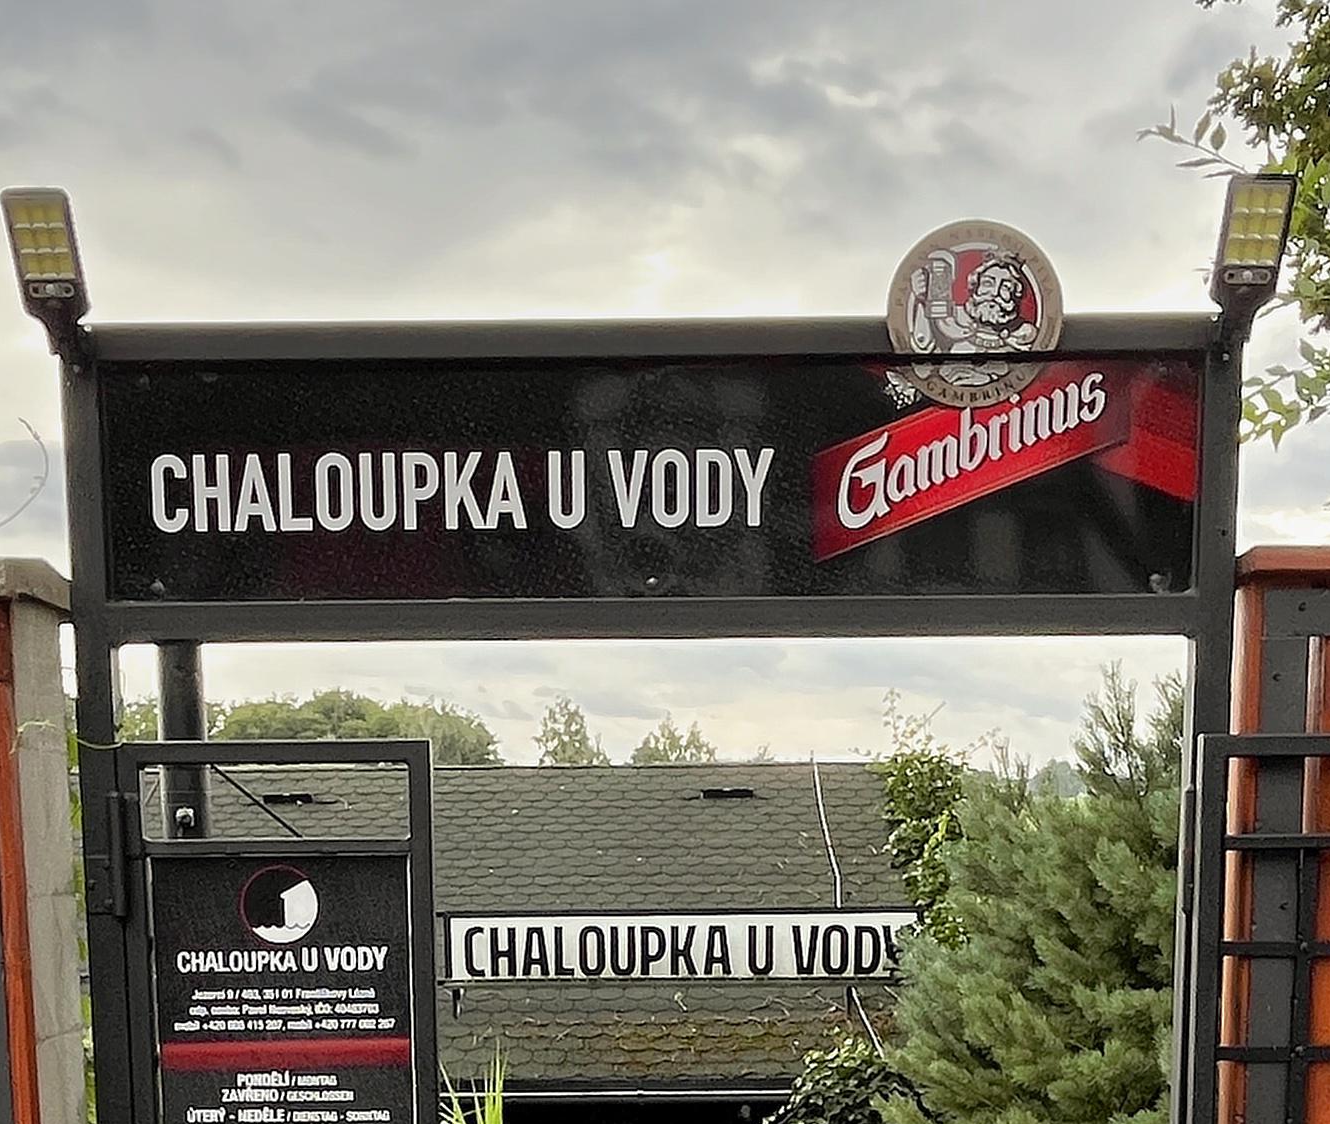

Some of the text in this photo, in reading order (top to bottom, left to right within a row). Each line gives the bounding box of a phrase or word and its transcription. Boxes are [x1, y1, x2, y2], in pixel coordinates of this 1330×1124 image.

[926, 367, 1029, 402] GAMBRINU
[837, 372, 1106, 529] Gambrinus
[150, 448, 775, 533] CHALOUPKA U VODY
[176, 945, 388, 974] CHALOUPKA U VODY
[464, 924, 733, 978] CHALOUPKA
[749, 924, 775, 976] U
